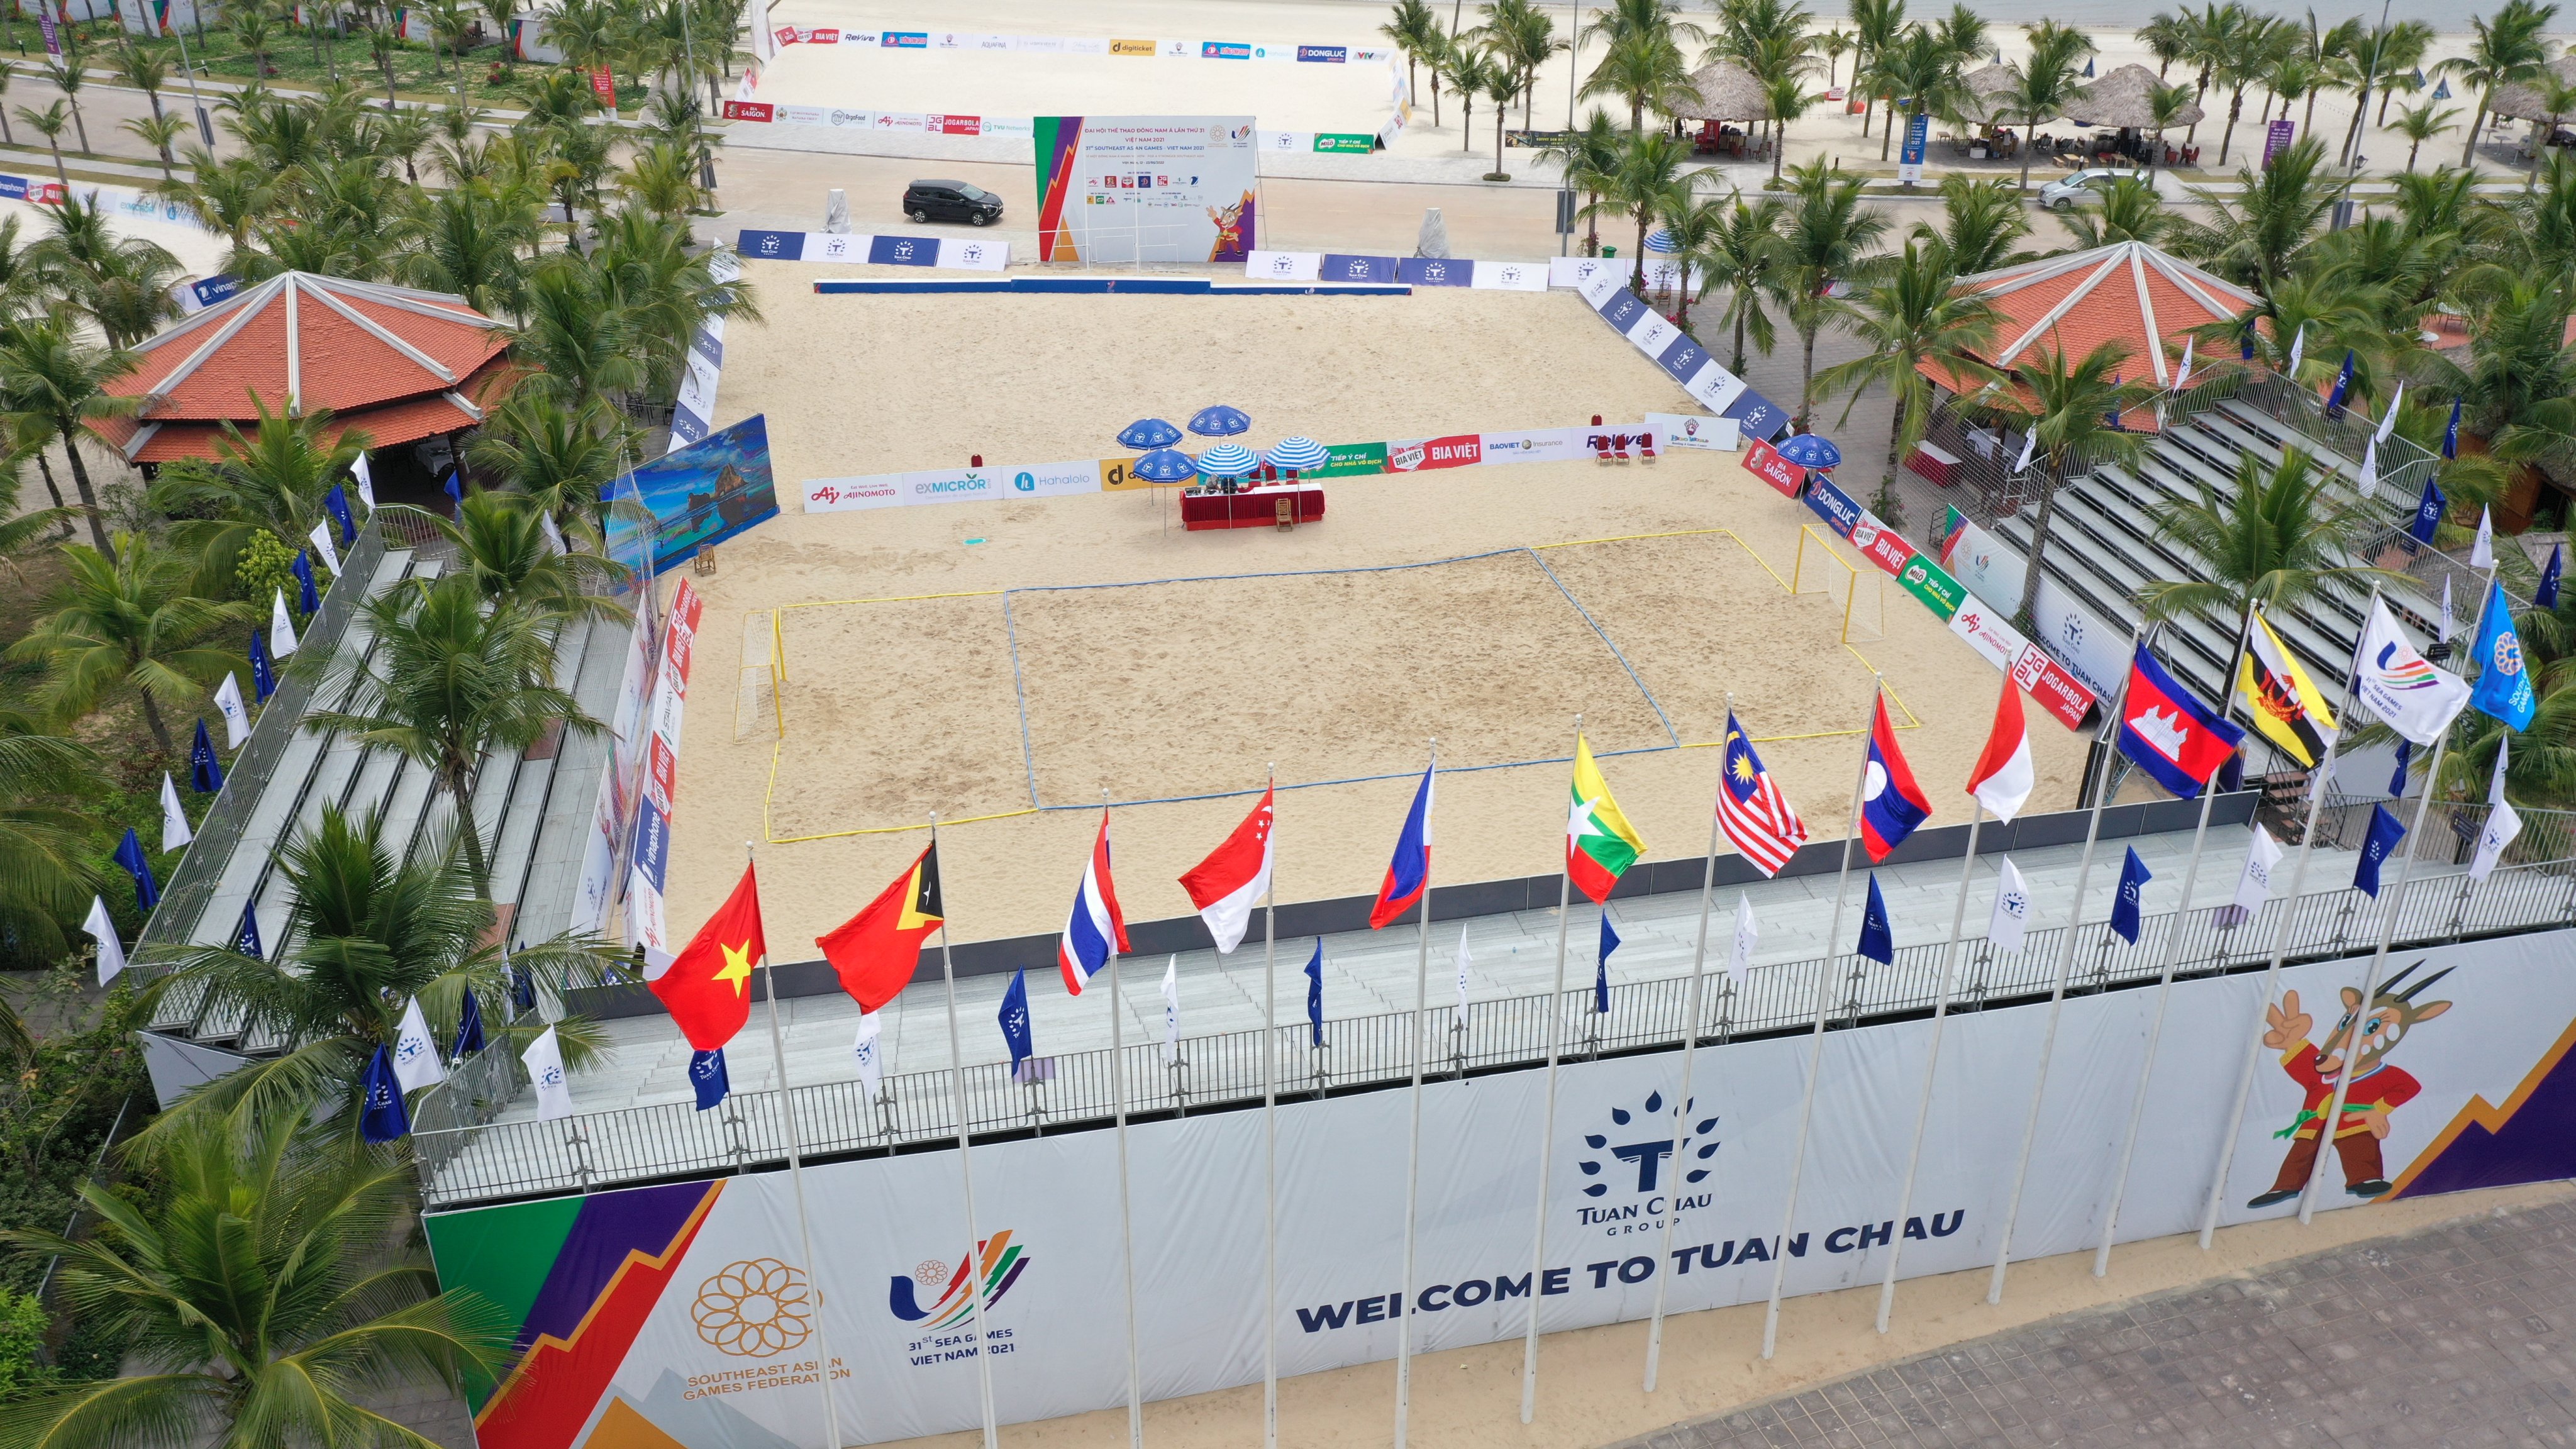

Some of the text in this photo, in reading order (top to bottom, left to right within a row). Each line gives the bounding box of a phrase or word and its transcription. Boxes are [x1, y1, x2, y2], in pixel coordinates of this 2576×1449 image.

[845, 34, 875, 42] ReVive
[981, 41, 1007, 49] AQUAFINA
[1308, 49, 1345, 57] DONGLUC
[741, 109, 766, 118] SAIGON
[1431, 442, 1479, 460] BIA VIỆT
[1489, 439, 1563, 450] BAOVIET Insurance
[1394, 450, 1423, 466] BIA VIỆT
[1777, 462, 1787, 472] BIA
[1039, 474, 1090, 486] Hahalolo
[1764, 462, 1792, 487] SAIGON
[843, 489, 896, 499] AJINOMOTO
[1817, 487, 1855, 526] DONGLUC
[1855, 528, 1875, 542] BIA VIỆT
[1875, 537, 1906, 570] BIA VIỆT
[1908, 568, 1924, 582] MILO
[1923, 585, 1933, 593] CHO
[1928, 577, 1939, 589] TIẾP
[1941, 589, 1951, 599] CHÍ
[1979, 631, 2008, 655] AJINOMOT
[2061, 652, 2113, 703] TO TUAN CHAU
[2041, 670, 2088, 714] JOGARBOLA
[2373, 684, 2403, 711] SEA GAMES
[663, 688, 674, 730] STAVIAN
[2060, 702, 2082, 723] JAPAN
[2369, 694, 2383, 708] NAM
[2382, 705, 2397, 718] 2021
[656, 763, 667, 785] BIA
[647, 811, 661, 865] vinaphone
[699, 1071, 712, 1080] TUAN
[1576, 1204, 1638, 1225] TUAN
[1607, 1218, 1680, 1236] GROUP
[1587, 1255, 1656, 1289] TO
[1670, 1231, 1809, 1275] TUAN
[1824, 1209, 1965, 1254] CHAU
[935, 1335, 962, 1348] SEA
[910, 1353, 942, 1366] VIET
[945, 1346, 979, 1362] NAM
[683, 1368, 851, 1401] GAMES FEDERATON
[687, 1364, 788, 1388] SOUTHEAST
